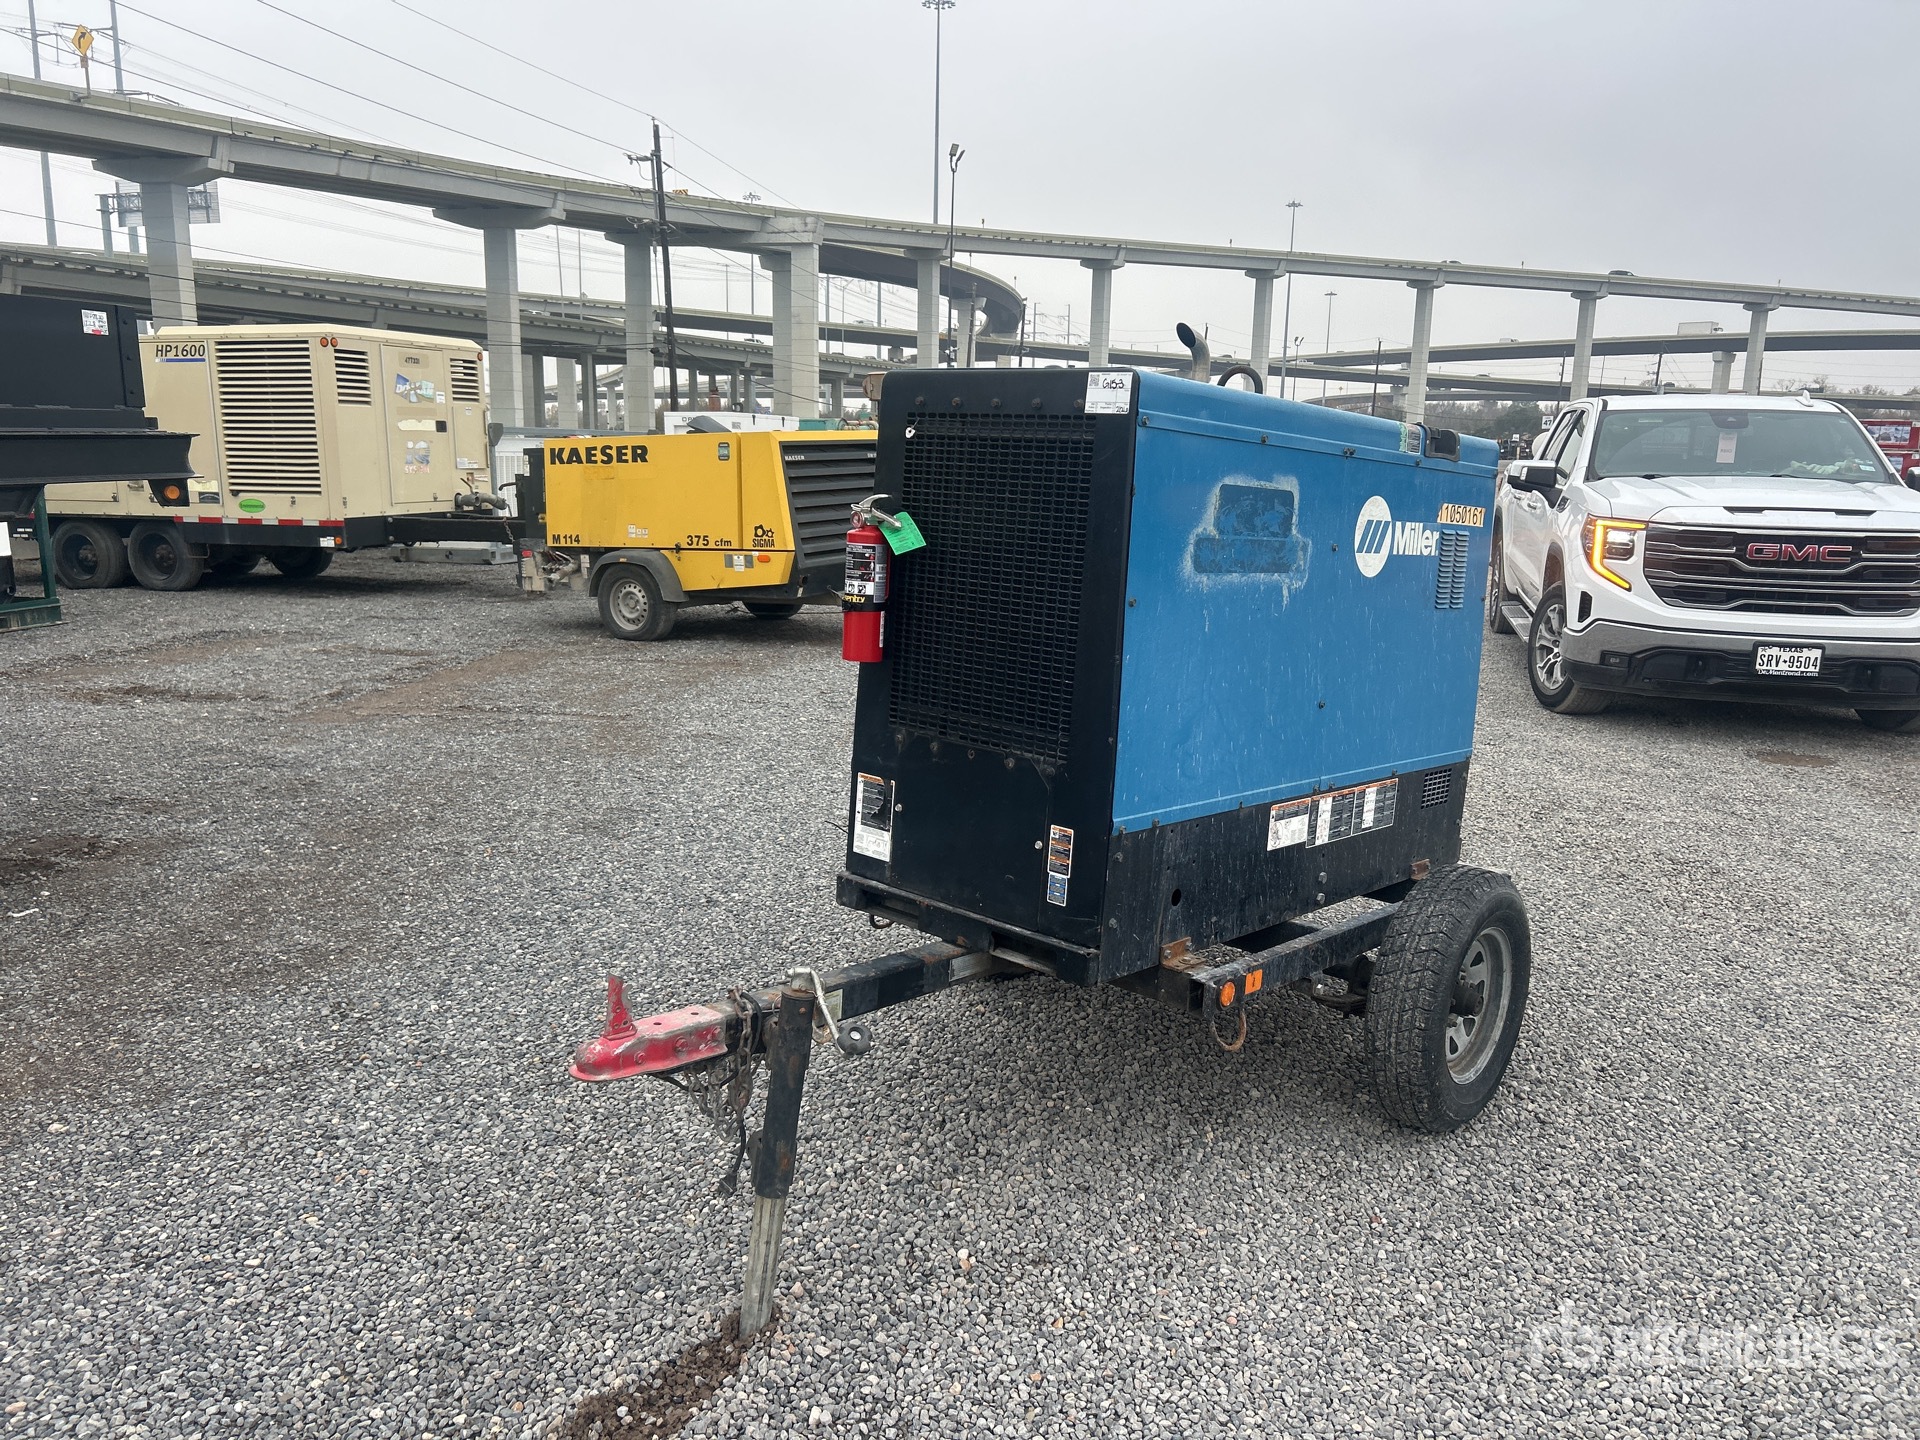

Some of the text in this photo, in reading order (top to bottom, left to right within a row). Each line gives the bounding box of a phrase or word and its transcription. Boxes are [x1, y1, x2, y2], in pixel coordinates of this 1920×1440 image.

[155, 344, 206, 358] HP1600
[1543, 419, 1553, 427] 47
[549, 444, 649, 465] KAESER
[552, 533, 581, 545] M 114
[686, 534, 733, 547] 375 cfm
[752, 537, 776, 548] SIGMA
[1746, 542, 1853, 563] GMC
